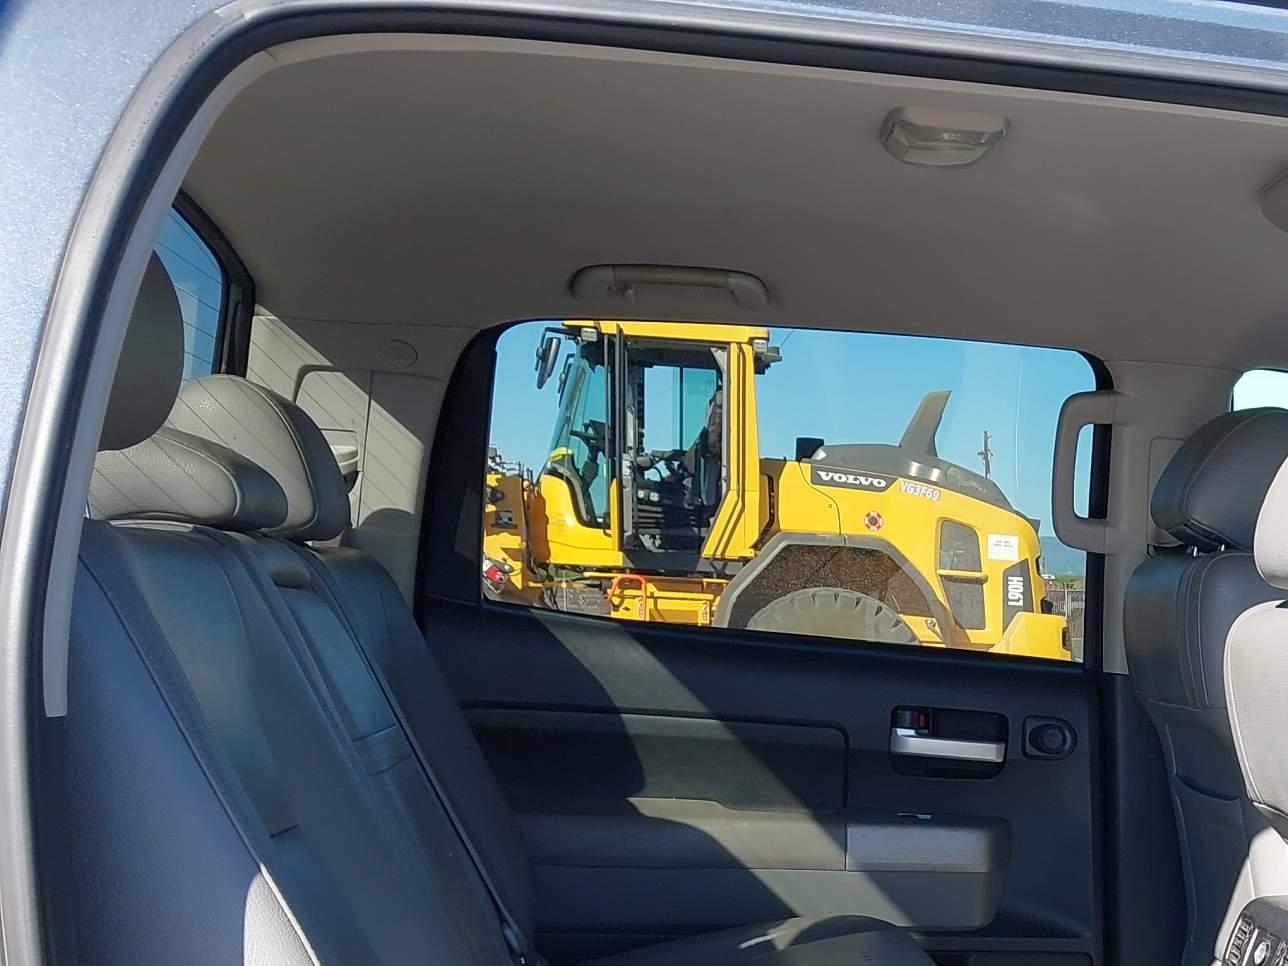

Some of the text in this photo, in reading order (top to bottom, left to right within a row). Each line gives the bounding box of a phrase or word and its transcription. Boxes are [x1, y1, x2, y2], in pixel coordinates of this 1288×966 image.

[817, 470, 887, 488] VOLVO
[899, 481, 940, 501] VG3F69
[1007, 576, 1024, 607] L90H
